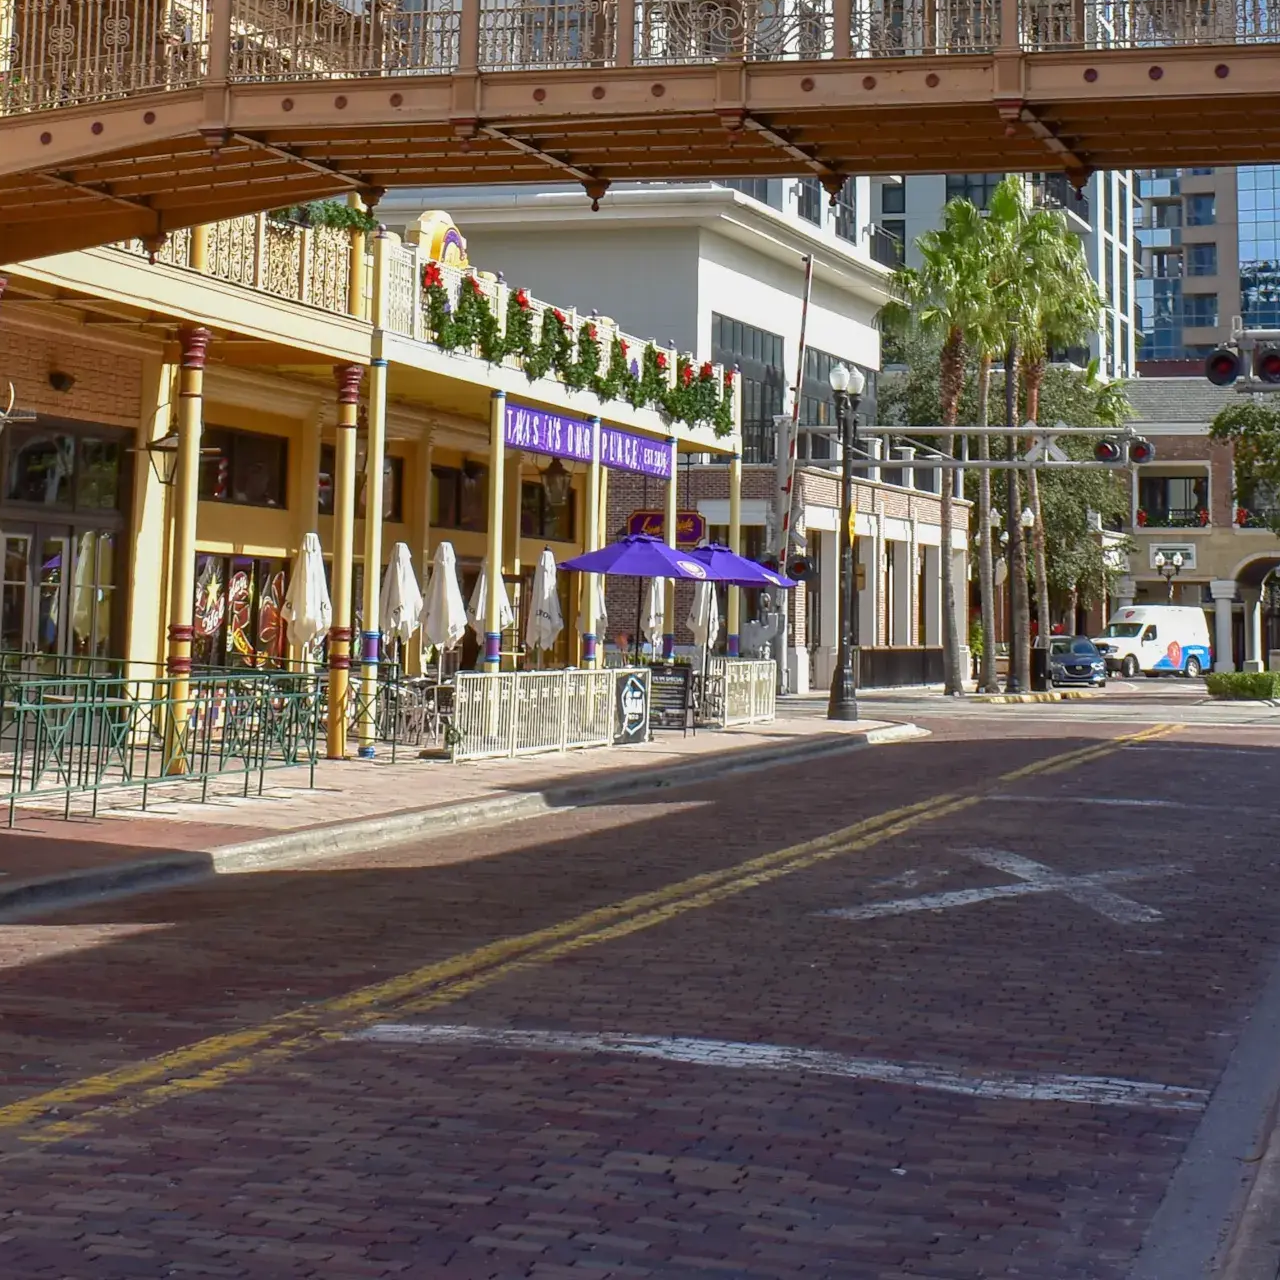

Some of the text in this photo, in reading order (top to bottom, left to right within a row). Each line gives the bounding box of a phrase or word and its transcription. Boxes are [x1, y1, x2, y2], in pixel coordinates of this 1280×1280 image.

[506, 410, 539, 446] THIS
[567, 424, 591, 459] OUR
[601, 433, 638, 466] PLACE
